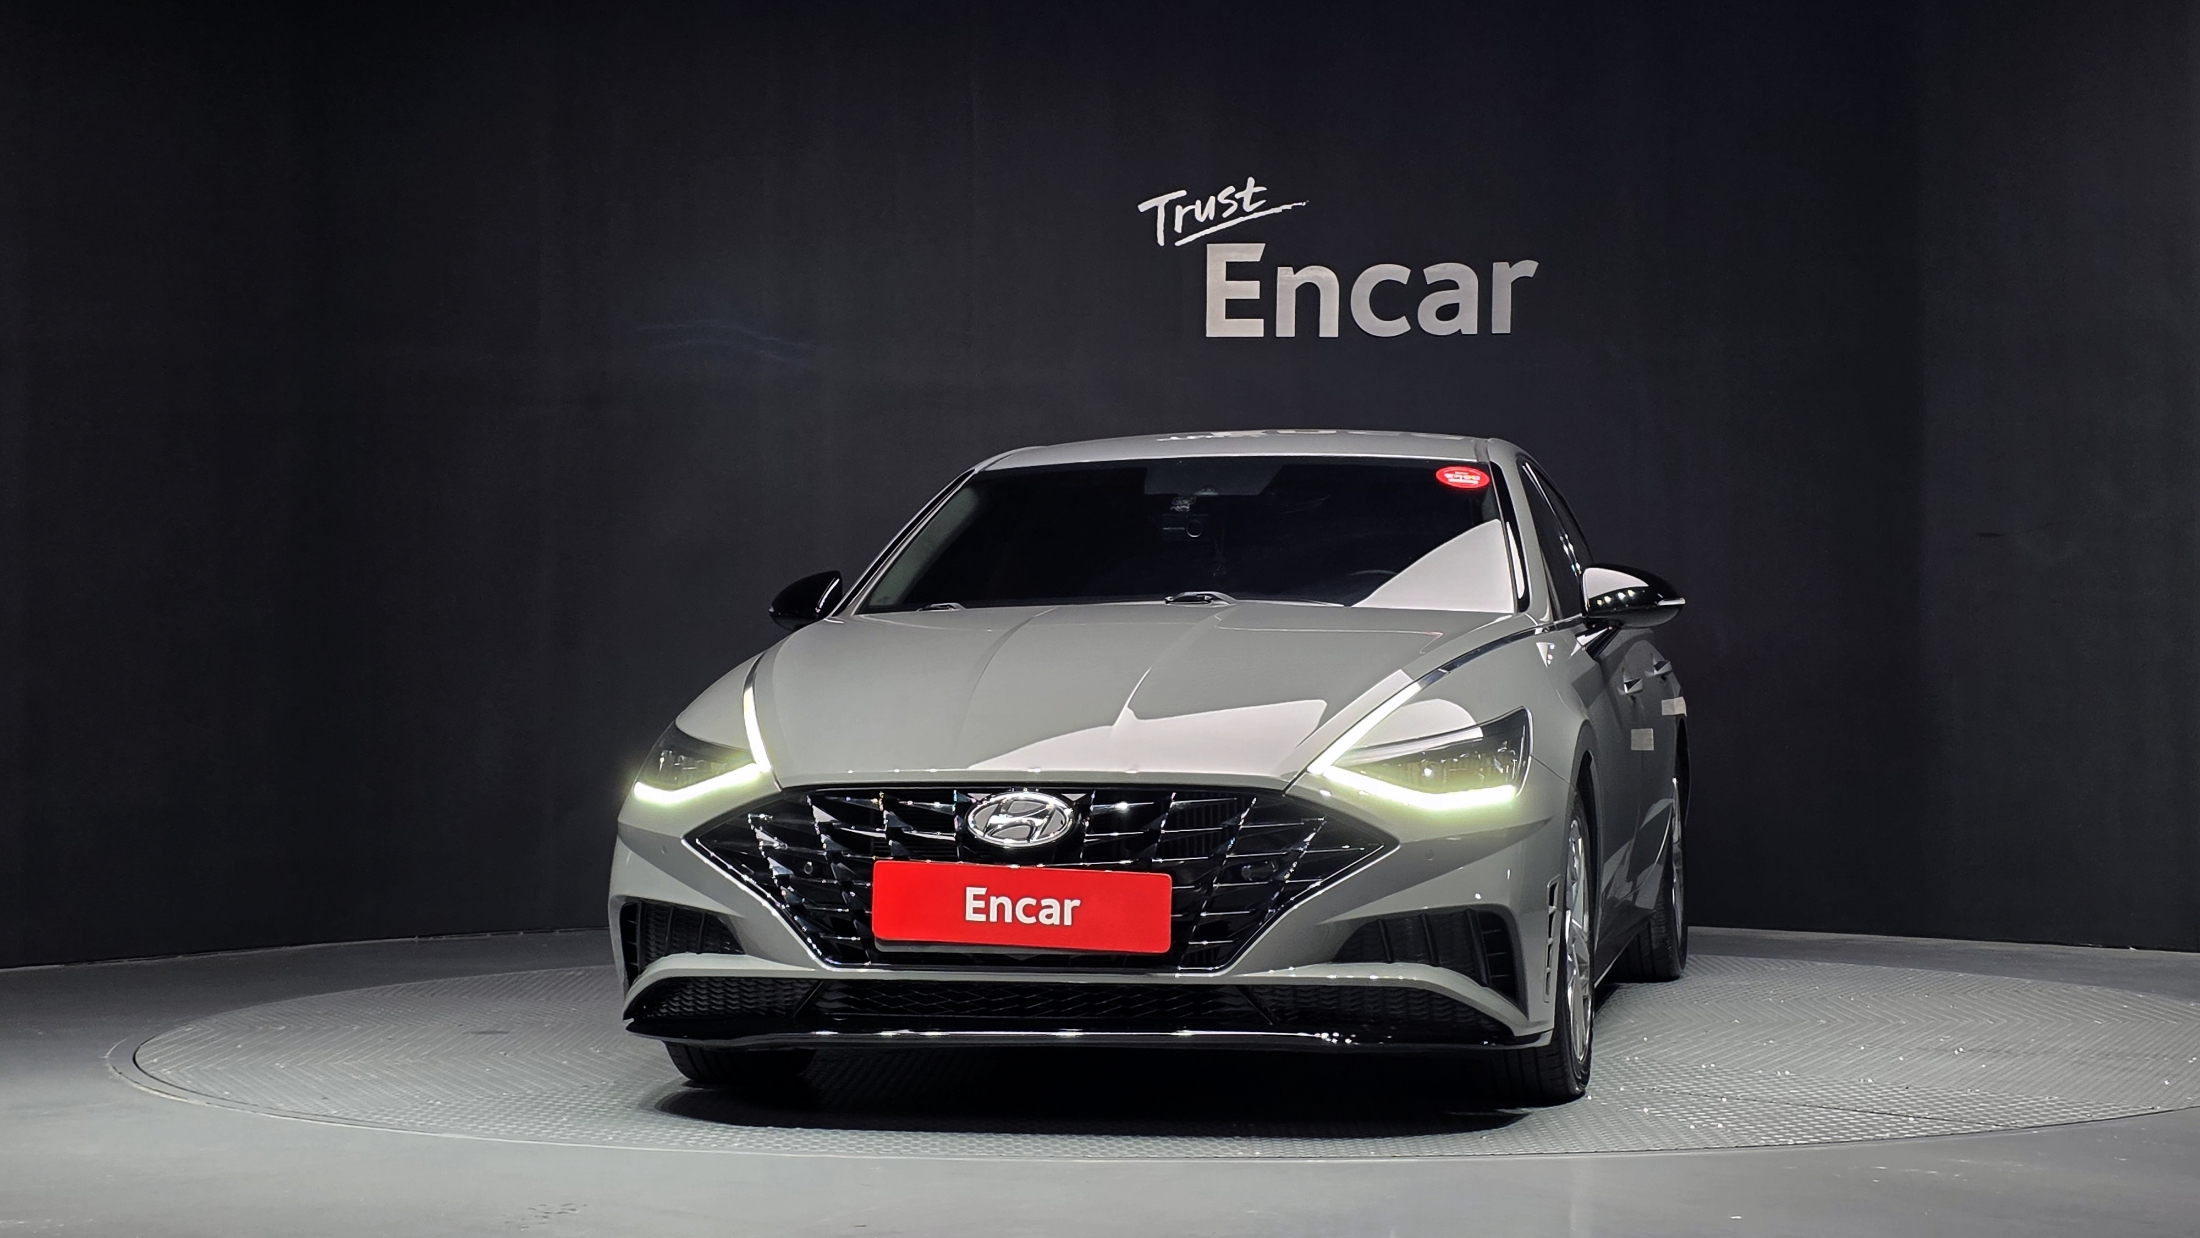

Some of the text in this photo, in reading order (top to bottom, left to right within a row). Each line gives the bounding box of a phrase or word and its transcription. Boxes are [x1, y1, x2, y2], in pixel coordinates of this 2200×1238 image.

[1138, 177, 1268, 247] Trust
[1206, 243, 1539, 338] Encar
[965, 886, 1082, 926] Encar
